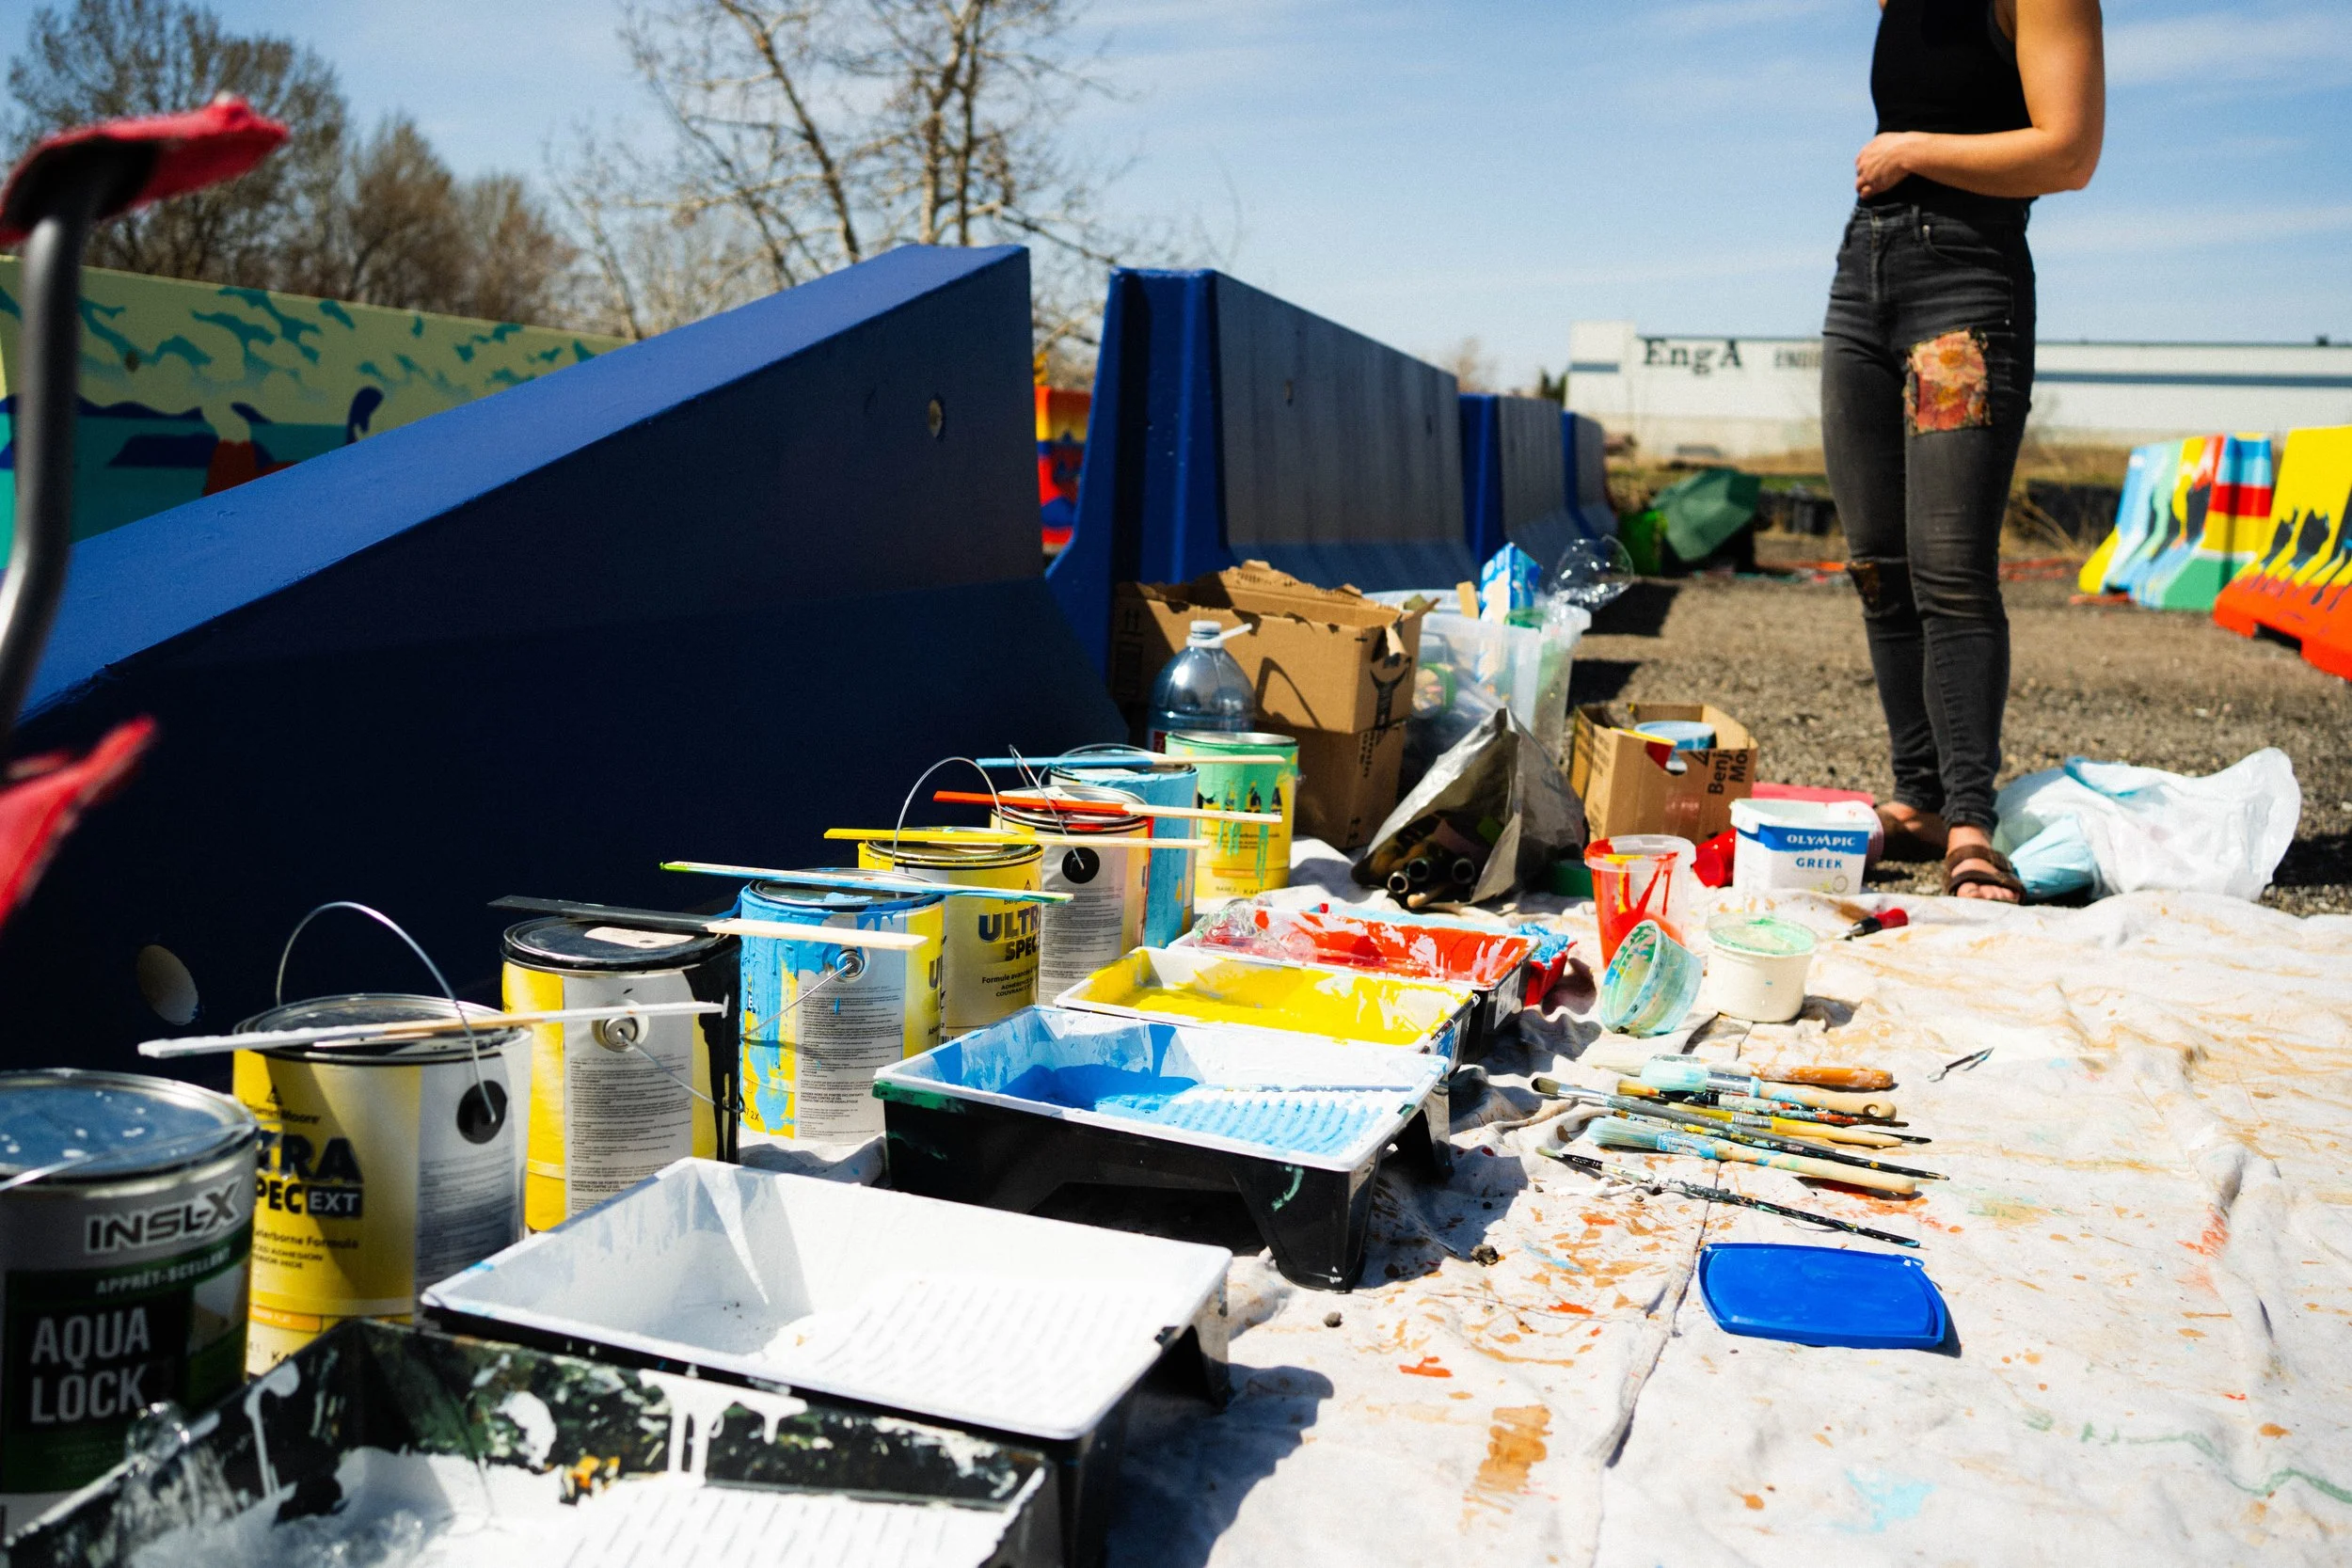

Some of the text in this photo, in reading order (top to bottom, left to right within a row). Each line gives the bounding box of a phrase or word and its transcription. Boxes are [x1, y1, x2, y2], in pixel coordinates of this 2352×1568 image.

[1644, 338, 1742, 374] EngA
[1787, 833, 1856, 847] OLYMPIC
[1796, 857, 1842, 869] GREEK
[978, 904, 1040, 942] ULTR
[982, 973, 1010, 984] Formule
[256, 1129, 363, 1183] TRA
[257, 1177, 360, 1213] PEC EXT
[86, 1178, 241, 1254] INSL-X
[31, 1307, 151, 1370] AQUA
[30, 1363, 149, 1424] LOCK
